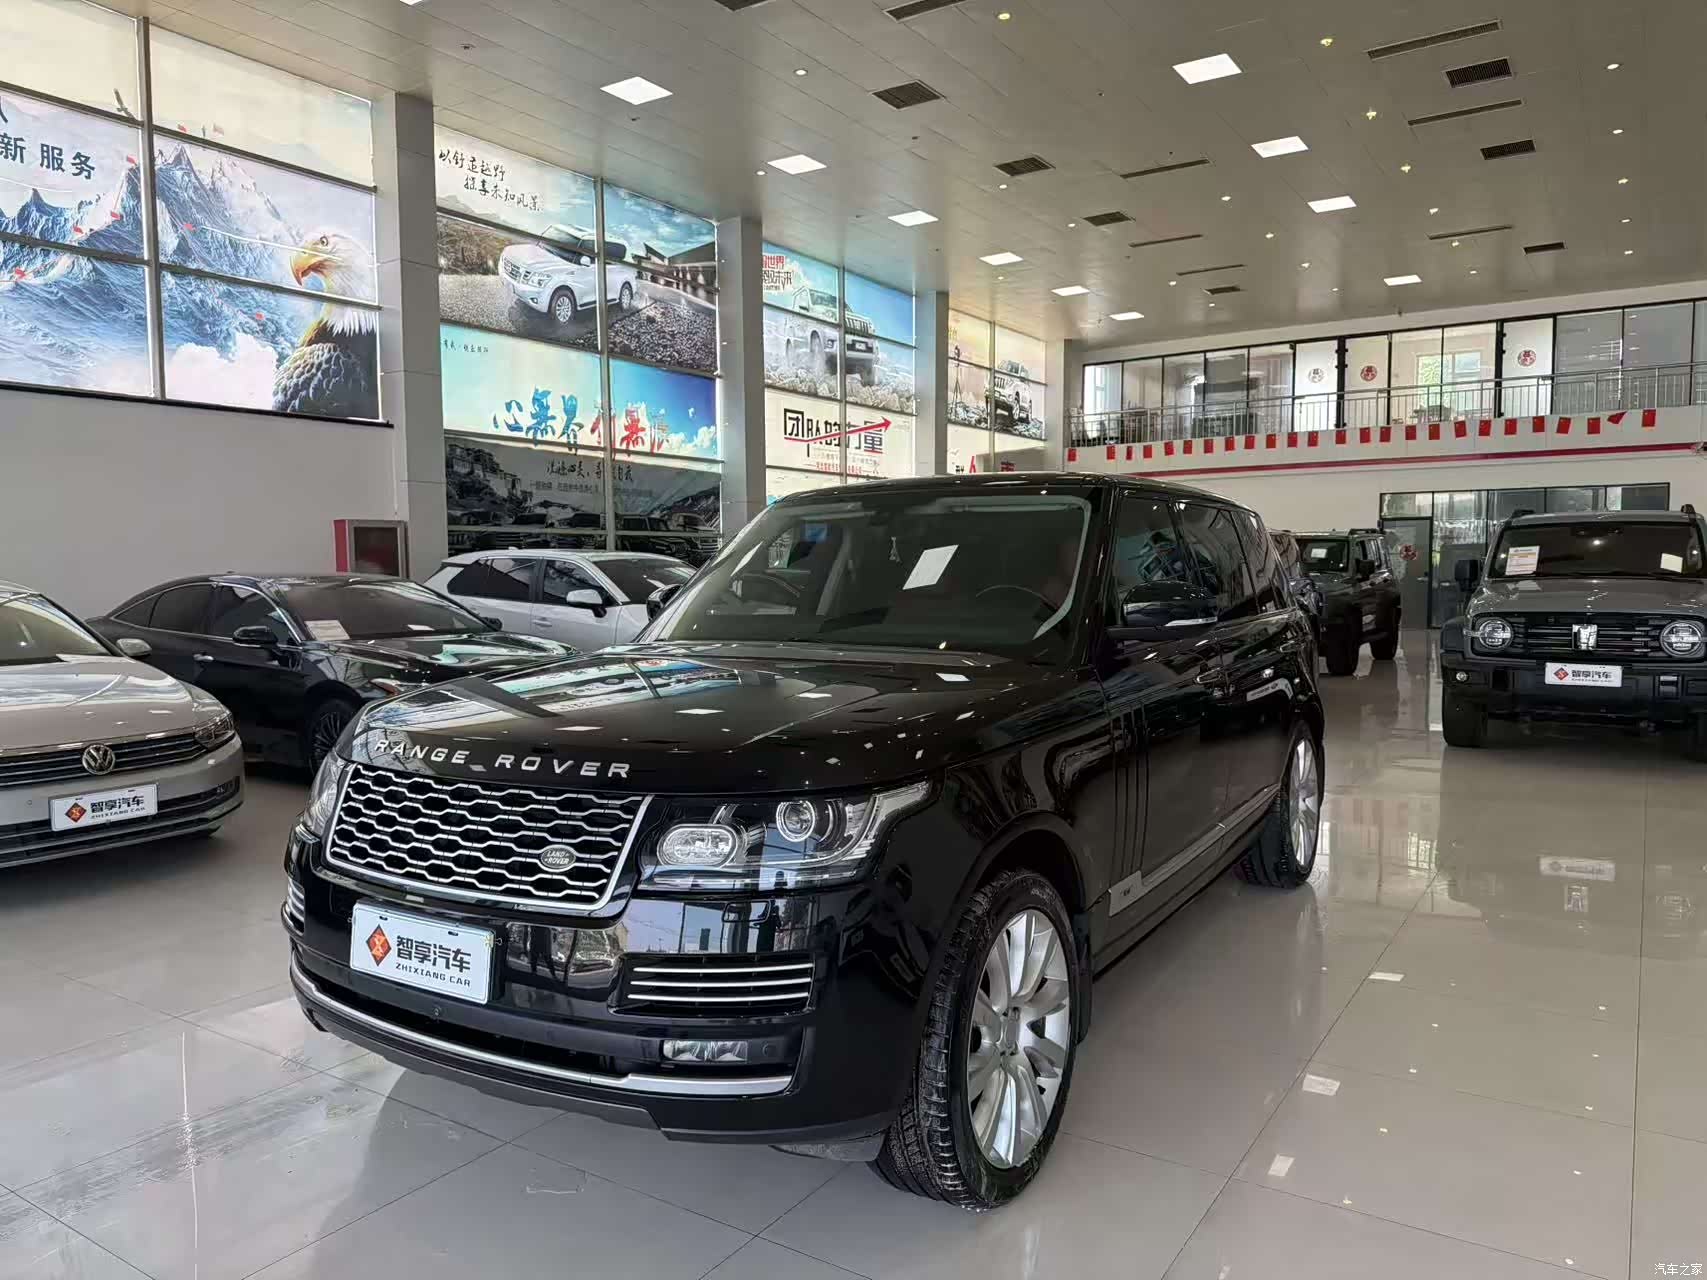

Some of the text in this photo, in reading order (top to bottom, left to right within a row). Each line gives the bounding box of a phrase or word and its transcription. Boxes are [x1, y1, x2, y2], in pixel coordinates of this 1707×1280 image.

[374, 739, 632, 778] RANGE ROVER
[90, 795, 145, 814] 智享汽车
[396, 935, 472, 973] 智享汽车
[395, 962, 471, 988] ZHIXIANG CAR
